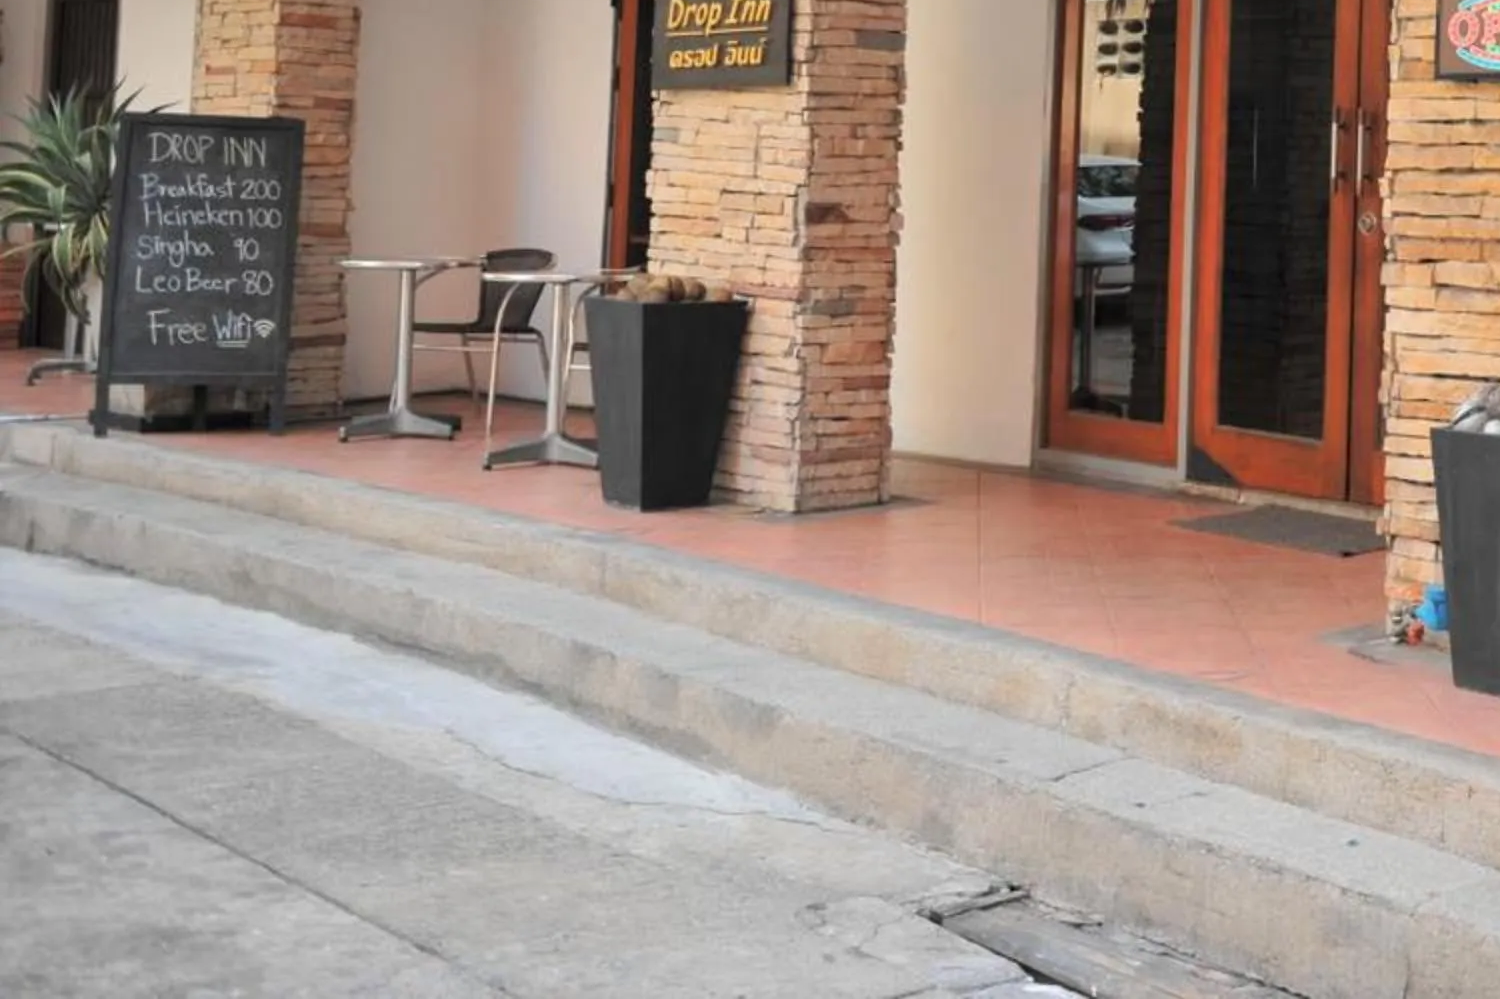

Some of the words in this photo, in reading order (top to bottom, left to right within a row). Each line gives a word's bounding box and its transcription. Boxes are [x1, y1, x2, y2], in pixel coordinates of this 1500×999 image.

[669, 43, 719, 69] ดรอป
[148, 132, 215, 164] DROP
[223, 136, 267, 168] INN
[139, 172, 236, 200] Breakfast
[240, 178, 281, 200] 200
[143, 200, 243, 228] Heineken
[246, 207, 282, 229] 100
[137, 229, 215, 268] Singha
[233, 237, 260, 261] 90
[135, 265, 180, 294] Leo
[184, 267, 237, 293] Beer
[241, 269, 274, 296] 80
[147, 307, 208, 346] Free
